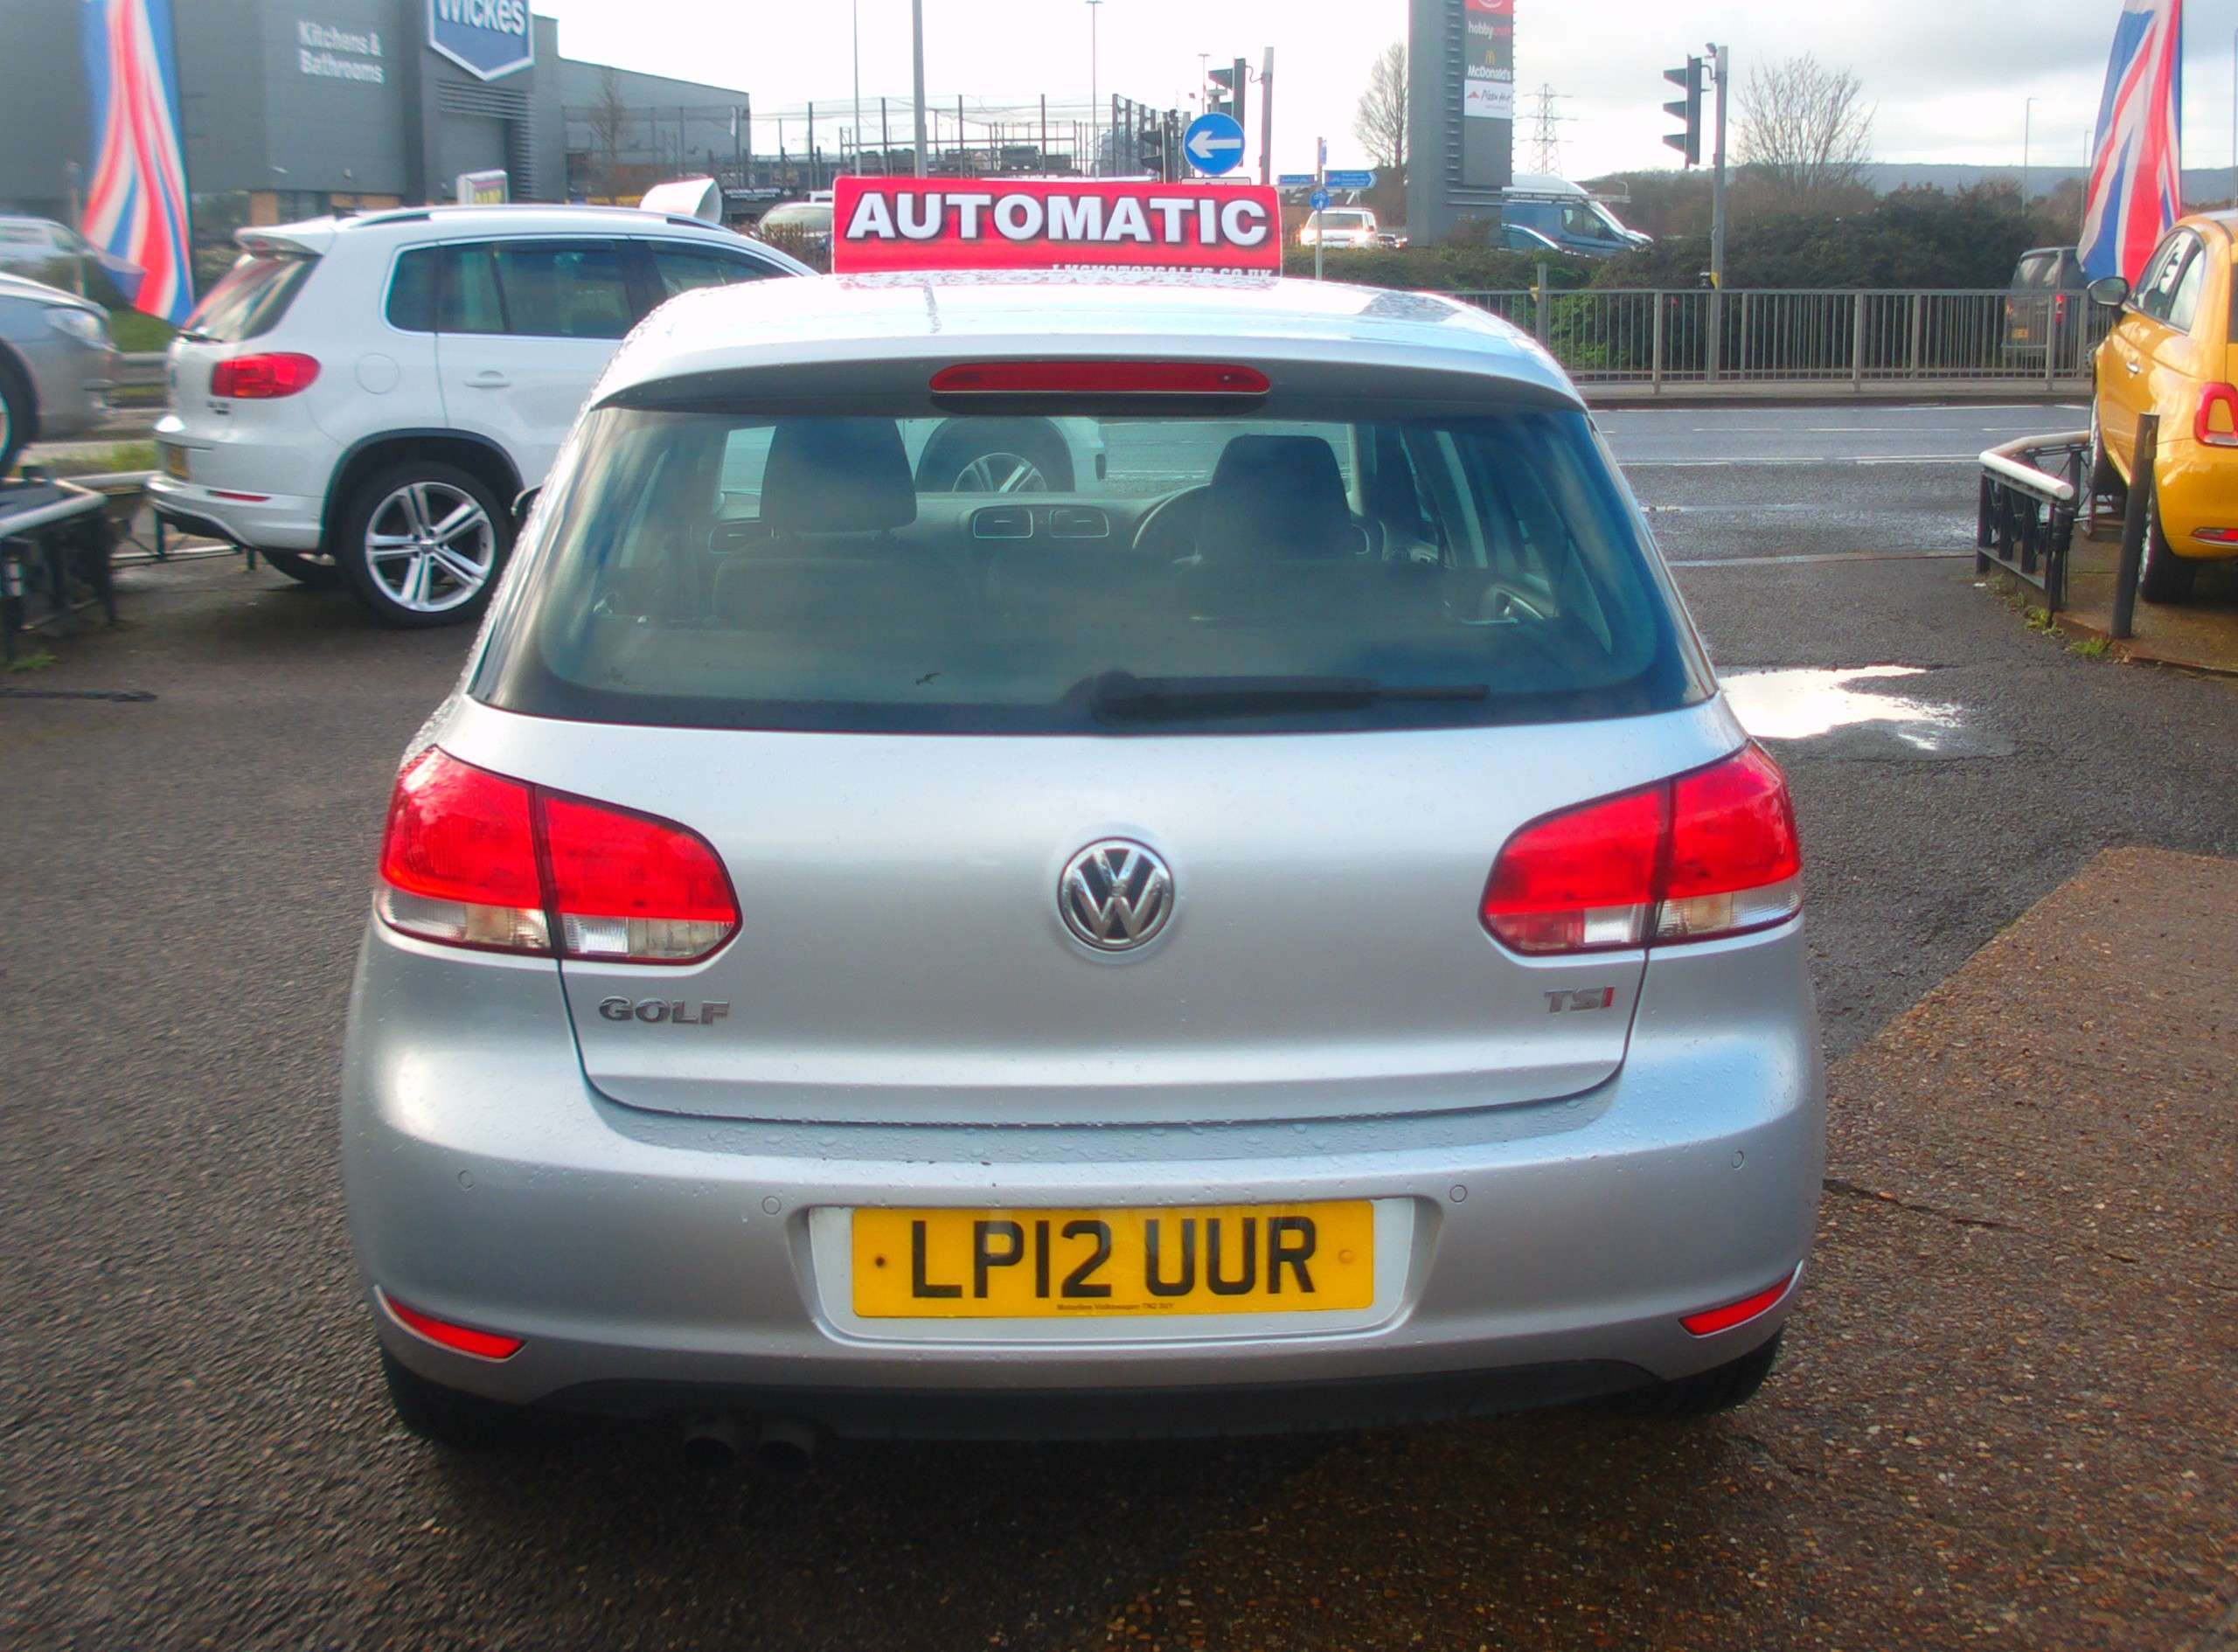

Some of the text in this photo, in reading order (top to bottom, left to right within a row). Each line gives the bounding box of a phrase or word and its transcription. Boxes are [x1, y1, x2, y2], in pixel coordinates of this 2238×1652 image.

[298, 19, 369, 56] Kitchens
[299, 48, 386, 84] Bathrooms
[1468, 65, 1512, 81] McDonald's
[846, 192, 1268, 246] AUTOMATIC
[599, 996, 729, 1024] GOLF
[1544, 986, 1616, 1013] TSI
[912, 1216, 1317, 1298] LP12 UUR
